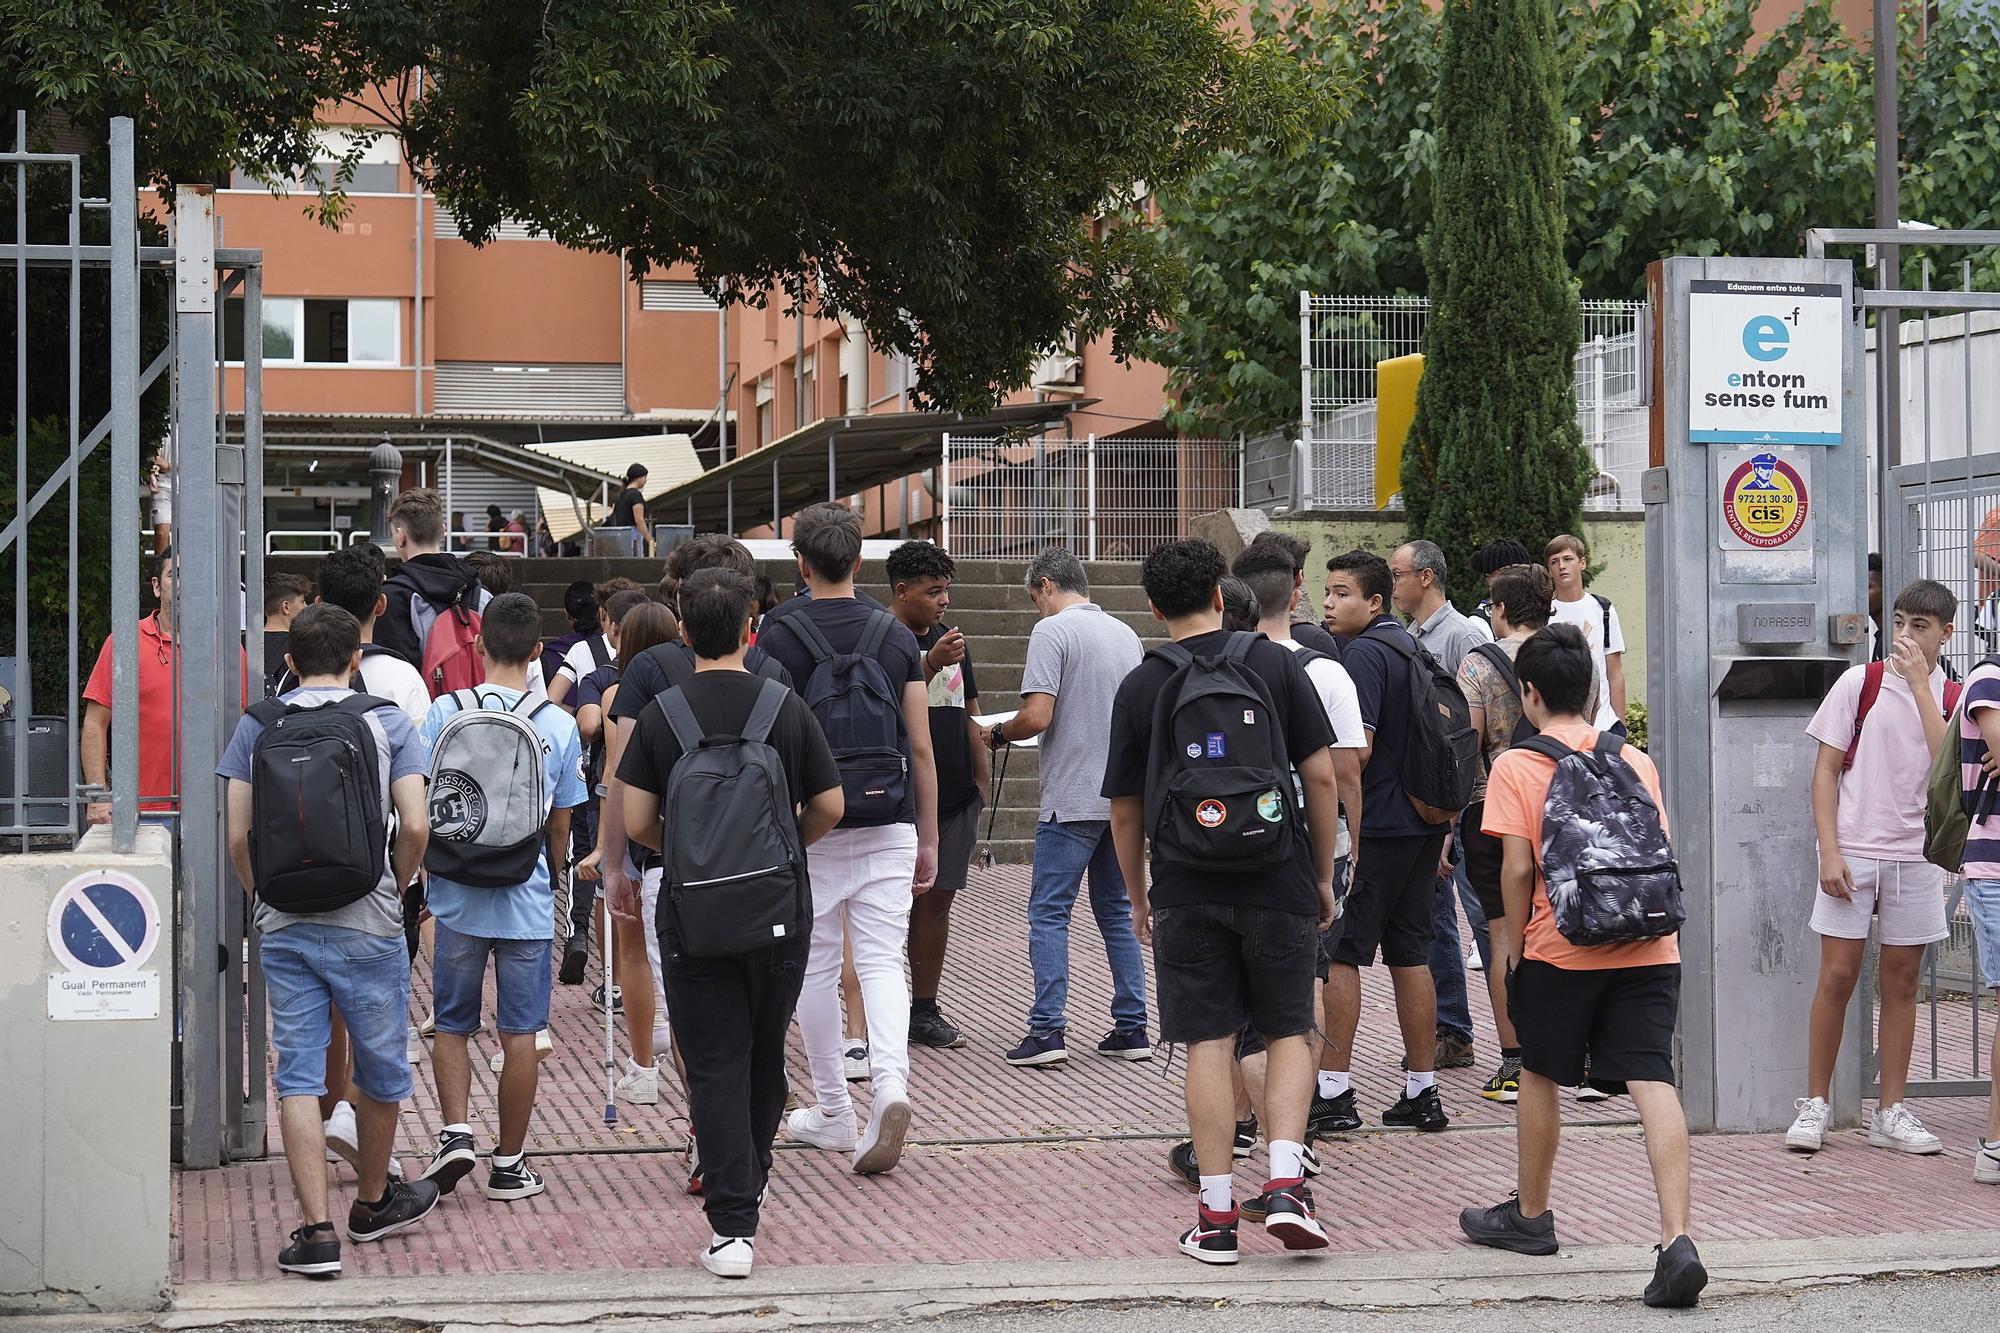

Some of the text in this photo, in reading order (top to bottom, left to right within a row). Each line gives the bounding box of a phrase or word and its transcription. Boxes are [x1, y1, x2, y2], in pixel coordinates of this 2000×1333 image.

[1728, 283, 1805, 293] Eduquem entre tots
[1727, 371, 1805, 388] entorn
[1705, 390, 1827, 409] sense fum
[1738, 494, 1793, 503] 972 21 30 30
[1751, 506, 1780, 520] cis
[1726, 505, 1805, 545] CENTRAL RECEPTORA D'ALARMES
[1769, 617, 1811, 627] PASSEU
[62, 980, 146, 990] Gual Permanent
